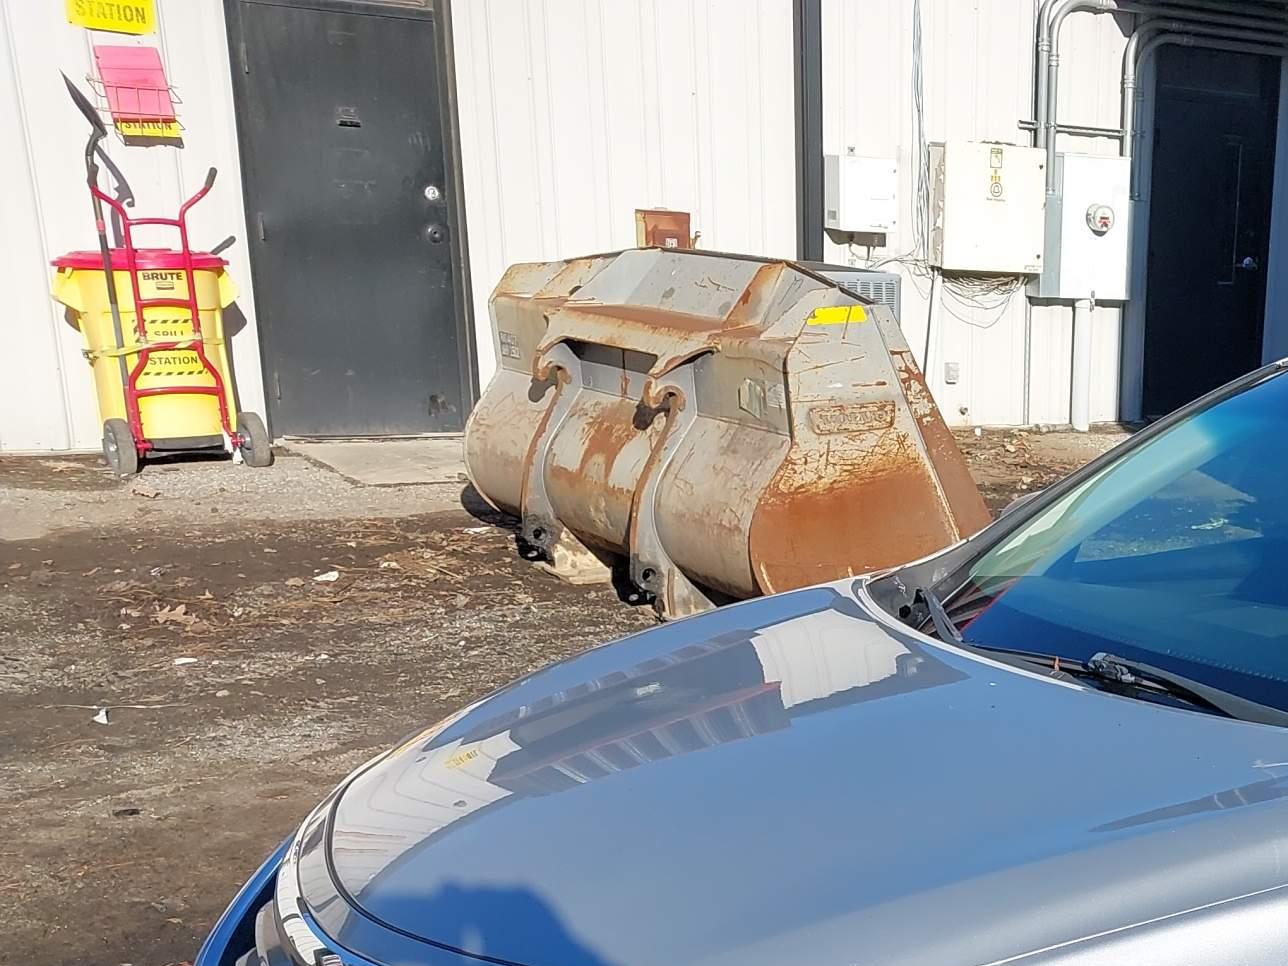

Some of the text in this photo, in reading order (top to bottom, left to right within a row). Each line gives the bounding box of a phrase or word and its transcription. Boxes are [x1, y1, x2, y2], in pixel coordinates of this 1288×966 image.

[75, 1, 147, 24] STATION
[142, 271, 183, 281] BRUTE
[149, 356, 198, 365] STATION
